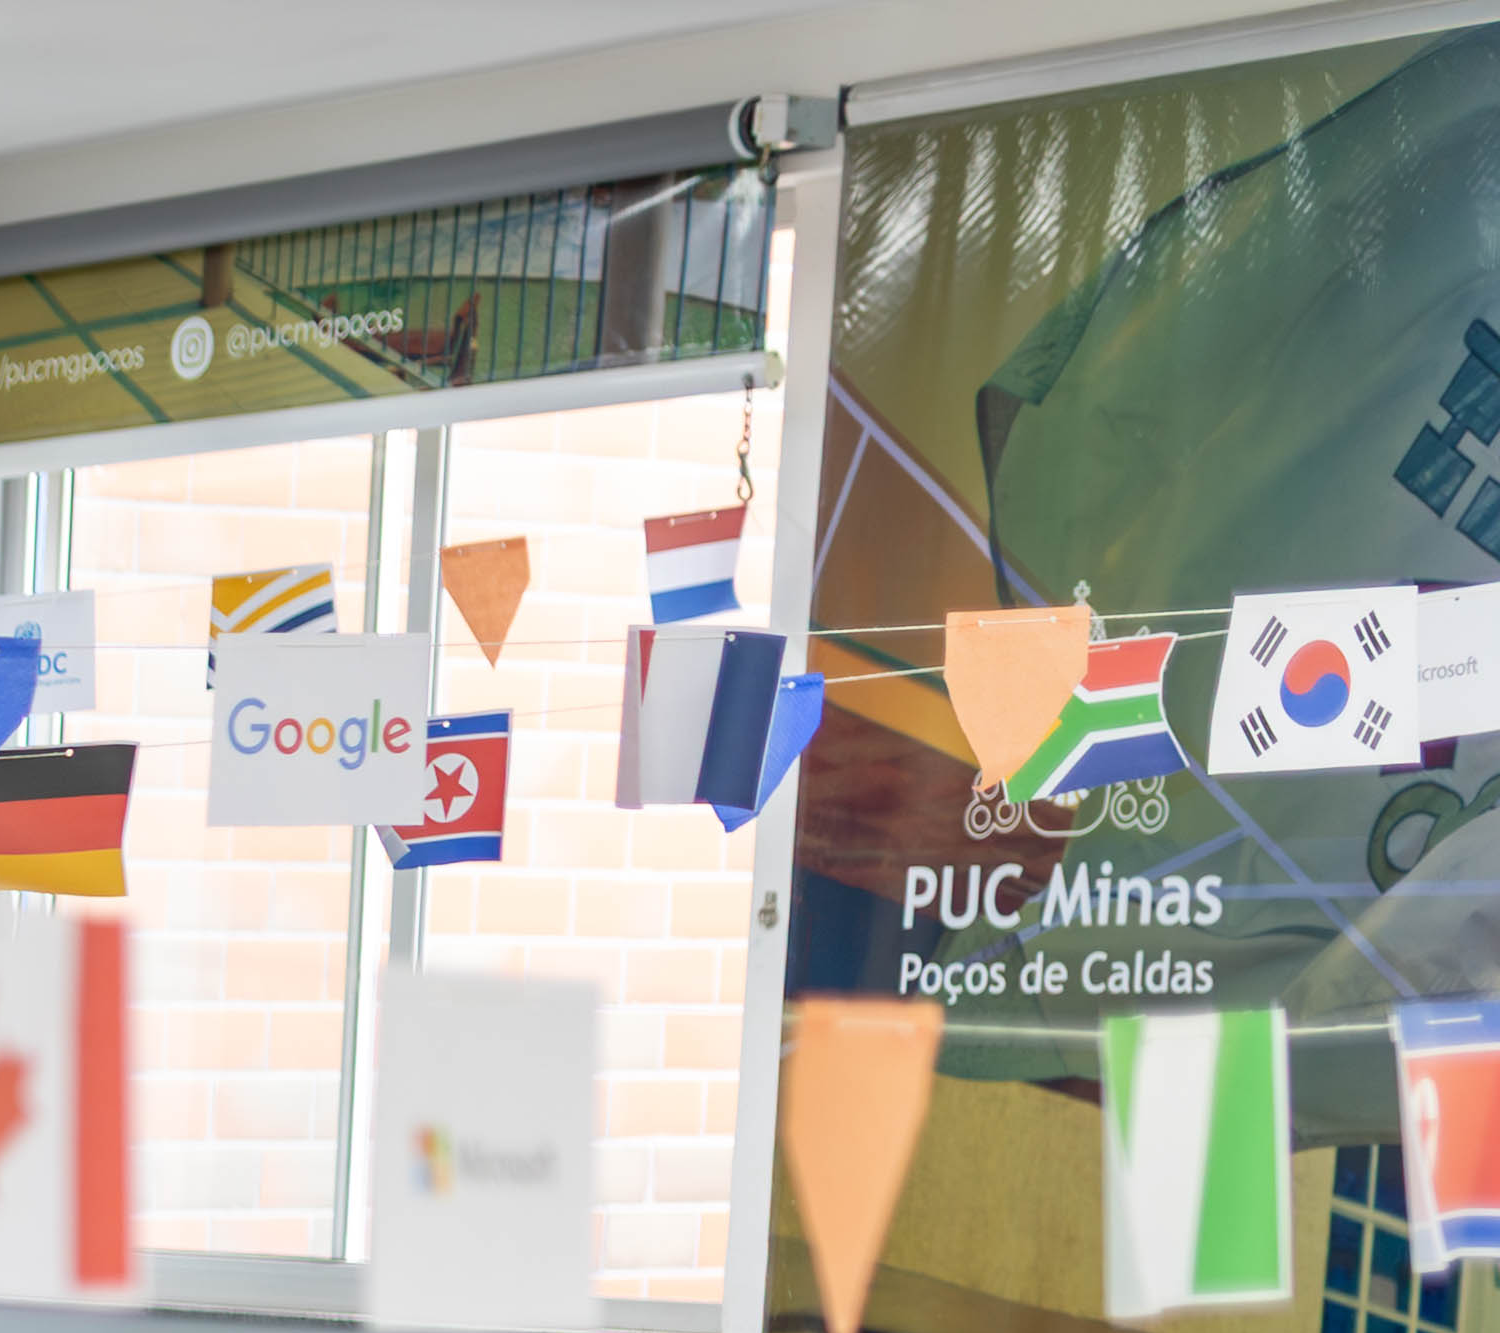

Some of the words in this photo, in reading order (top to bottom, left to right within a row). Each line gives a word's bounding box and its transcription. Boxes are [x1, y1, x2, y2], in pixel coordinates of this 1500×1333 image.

[227, 308, 403, 357] @pucmgpocos
[1417, 656, 1478, 683] icrosoft
[228, 697, 411, 770] Google
[903, 863, 1023, 930] PUC
[1042, 860, 1223, 928] Minas
[899, 953, 1006, 1005] Poços
[1020, 951, 1068, 995] de
[1082, 950, 1213, 995] Caldas
